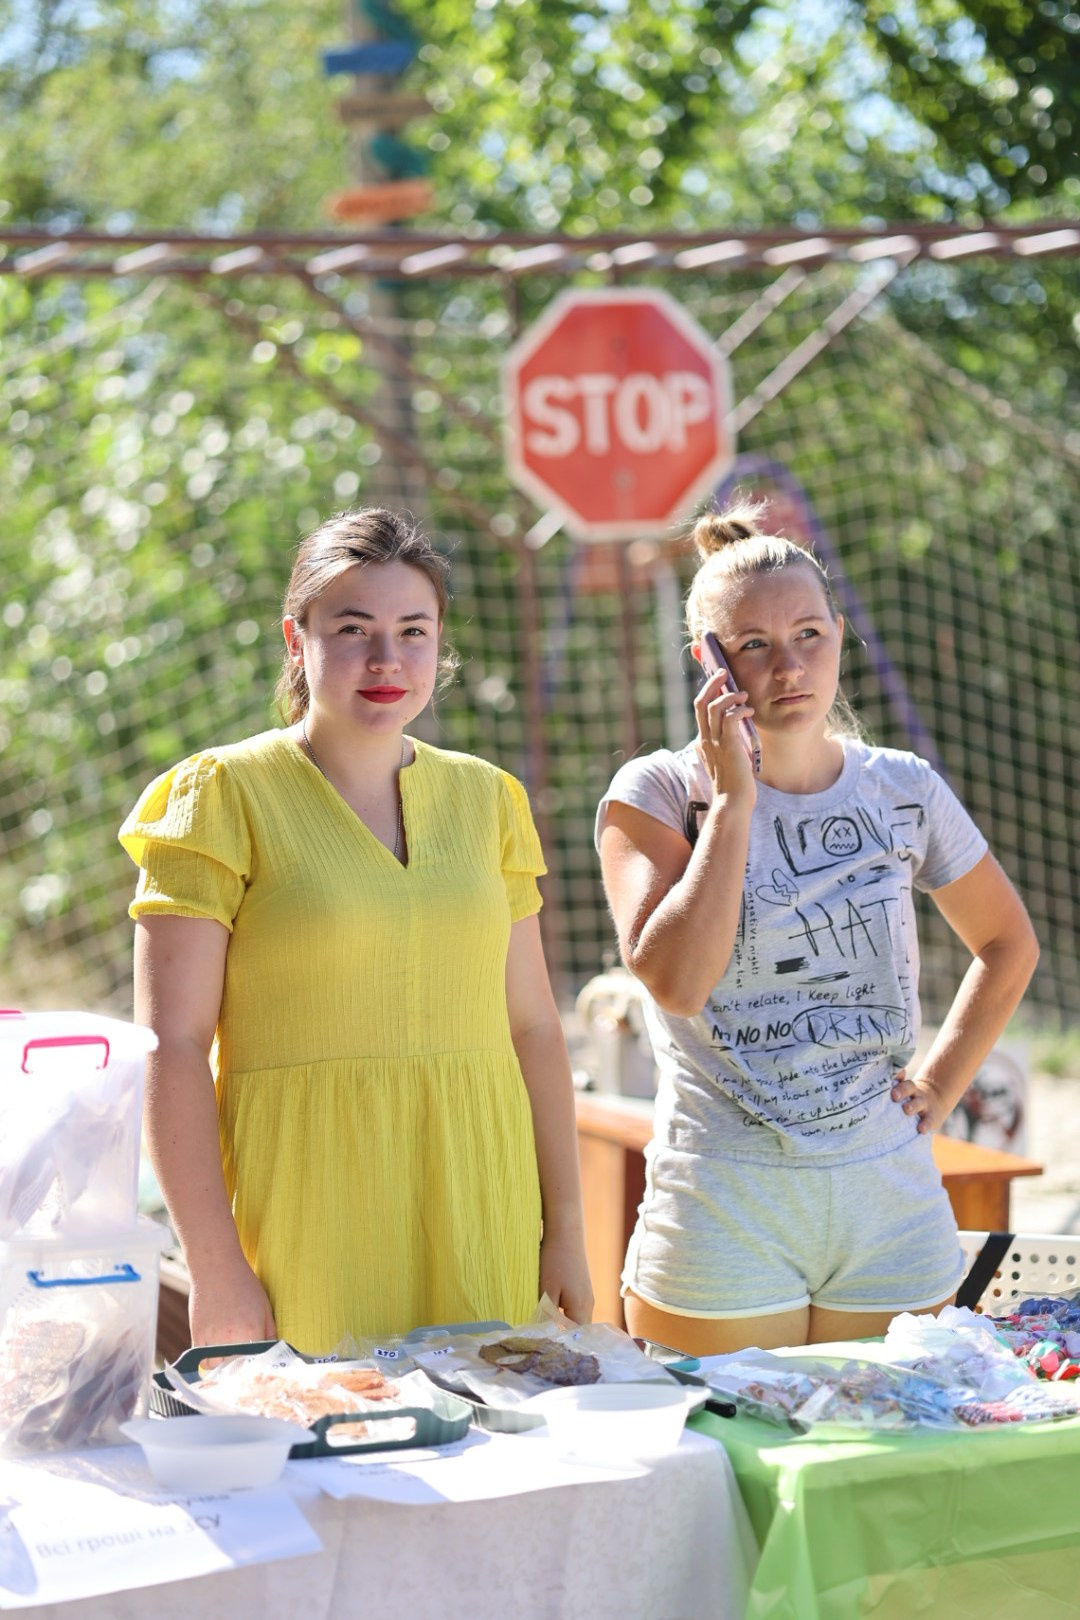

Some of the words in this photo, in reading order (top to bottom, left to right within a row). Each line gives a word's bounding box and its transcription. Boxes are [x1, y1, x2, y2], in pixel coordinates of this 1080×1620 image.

[523, 371, 712, 458] STOP
[846, 983, 878, 1001] light
[735, 1025, 761, 1047] NO
[766, 1020, 792, 1042] NO
[821, 1058, 839, 1072] the
[810, 1106, 822, 1119] up
[35, 1540, 72, 1560] Всі
[77, 1525, 142, 1554] гроші
[147, 1523, 178, 1540] на
